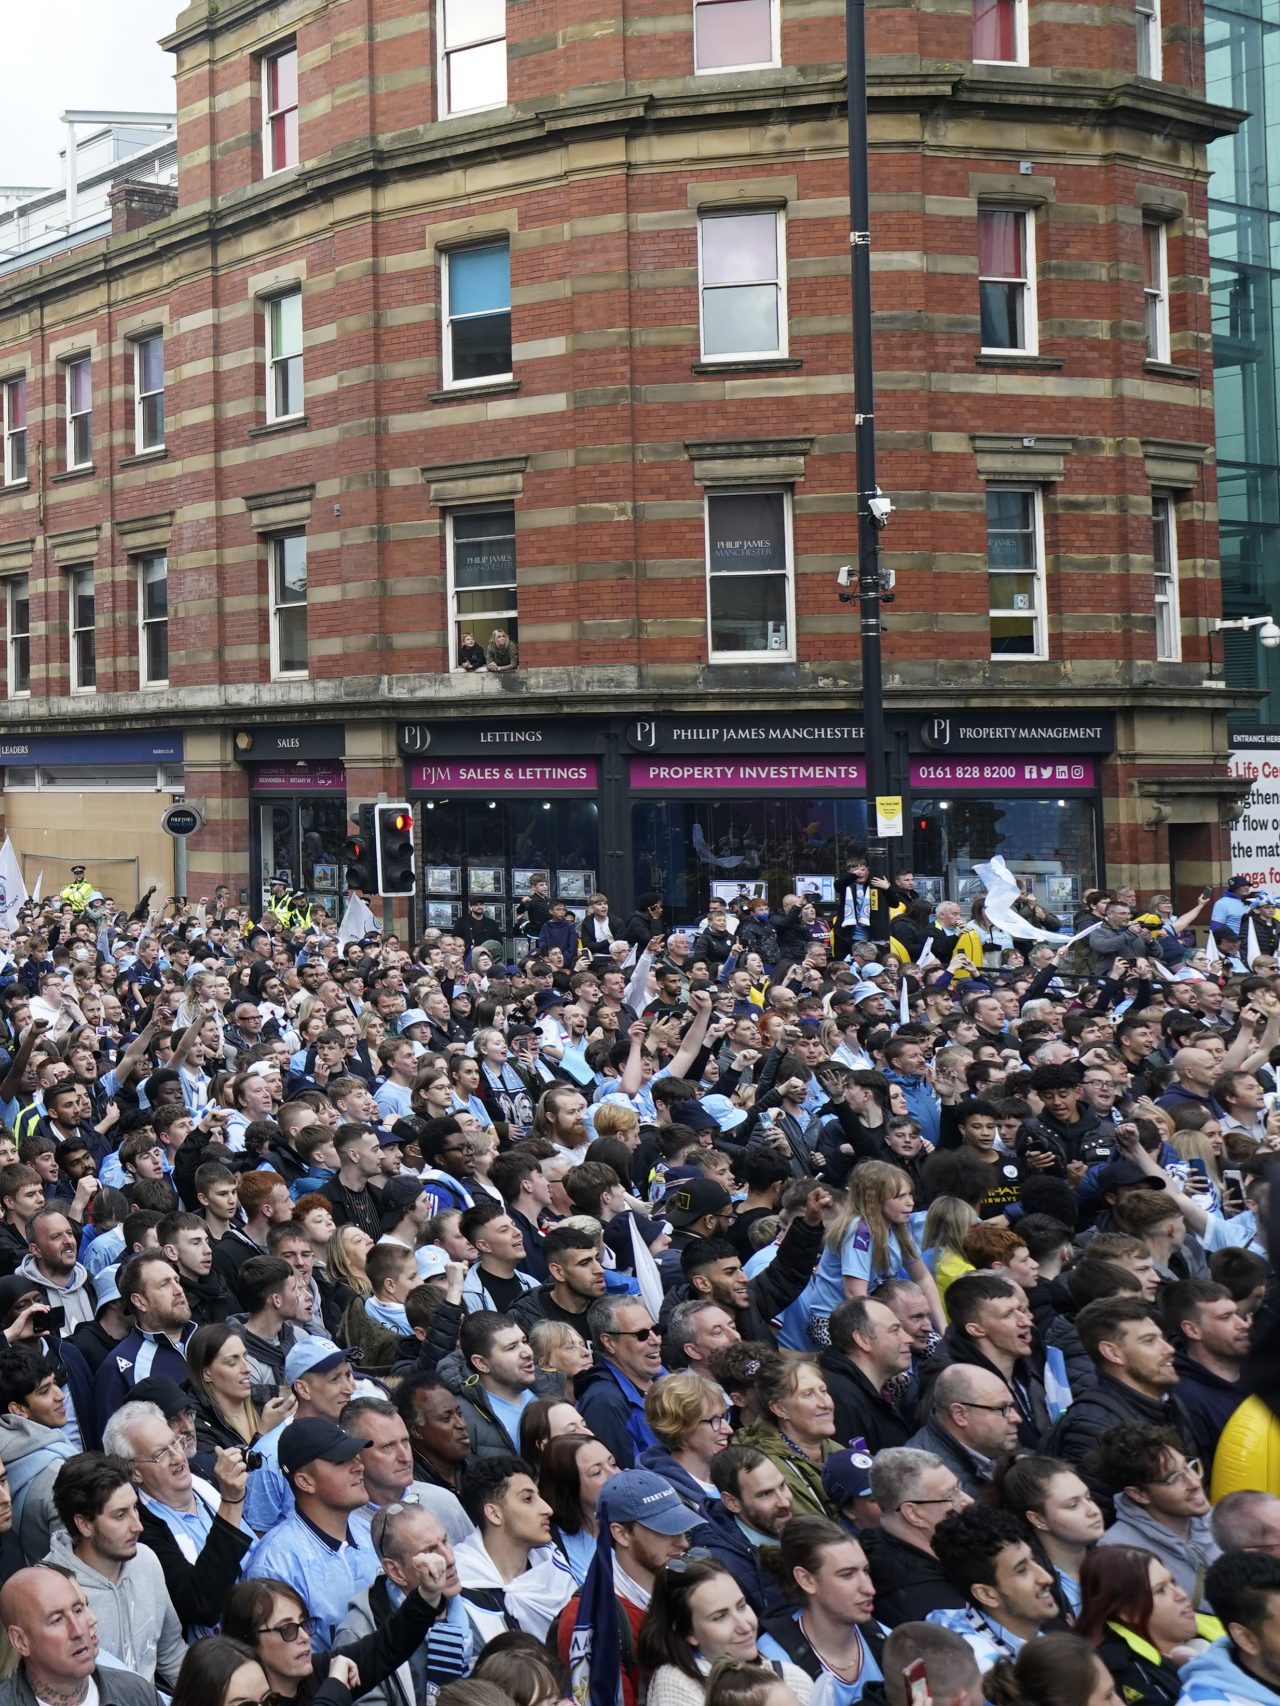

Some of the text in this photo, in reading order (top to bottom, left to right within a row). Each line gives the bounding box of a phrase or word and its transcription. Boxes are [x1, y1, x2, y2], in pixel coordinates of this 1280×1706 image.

[744, 540, 771, 549] JAMES
[489, 554, 512, 564] JAMES
[480, 731, 543, 743] LETTINGS
[636, 722, 656, 747] PJ
[673, 728, 720, 740] PHILIP
[722, 728, 765, 742] JAMES
[933, 719, 950, 745] PJ
[959, 727, 1102, 739] PROPERTY MANAGEMENT
[277, 738, 300, 748] SALES
[1232, 735, 1266, 743] ENTRANCE
[1, 745, 29, 755] LEADERS
[422, 767, 587, 784] PJM SALES & LETTINGS
[649, 766, 858, 779] PROPERTY INVESTMENTS
[919, 766, 1016, 779] 0161 828 8200
[1236, 762, 1259, 778] Life
[1262, 763, 1280, 778] Ce
[1239, 789, 1280, 809] gthen
[1243, 814, 1269, 831] flow
[1232, 842, 1280, 858] the mat
[642, 1493, 662, 1504] FERRY
